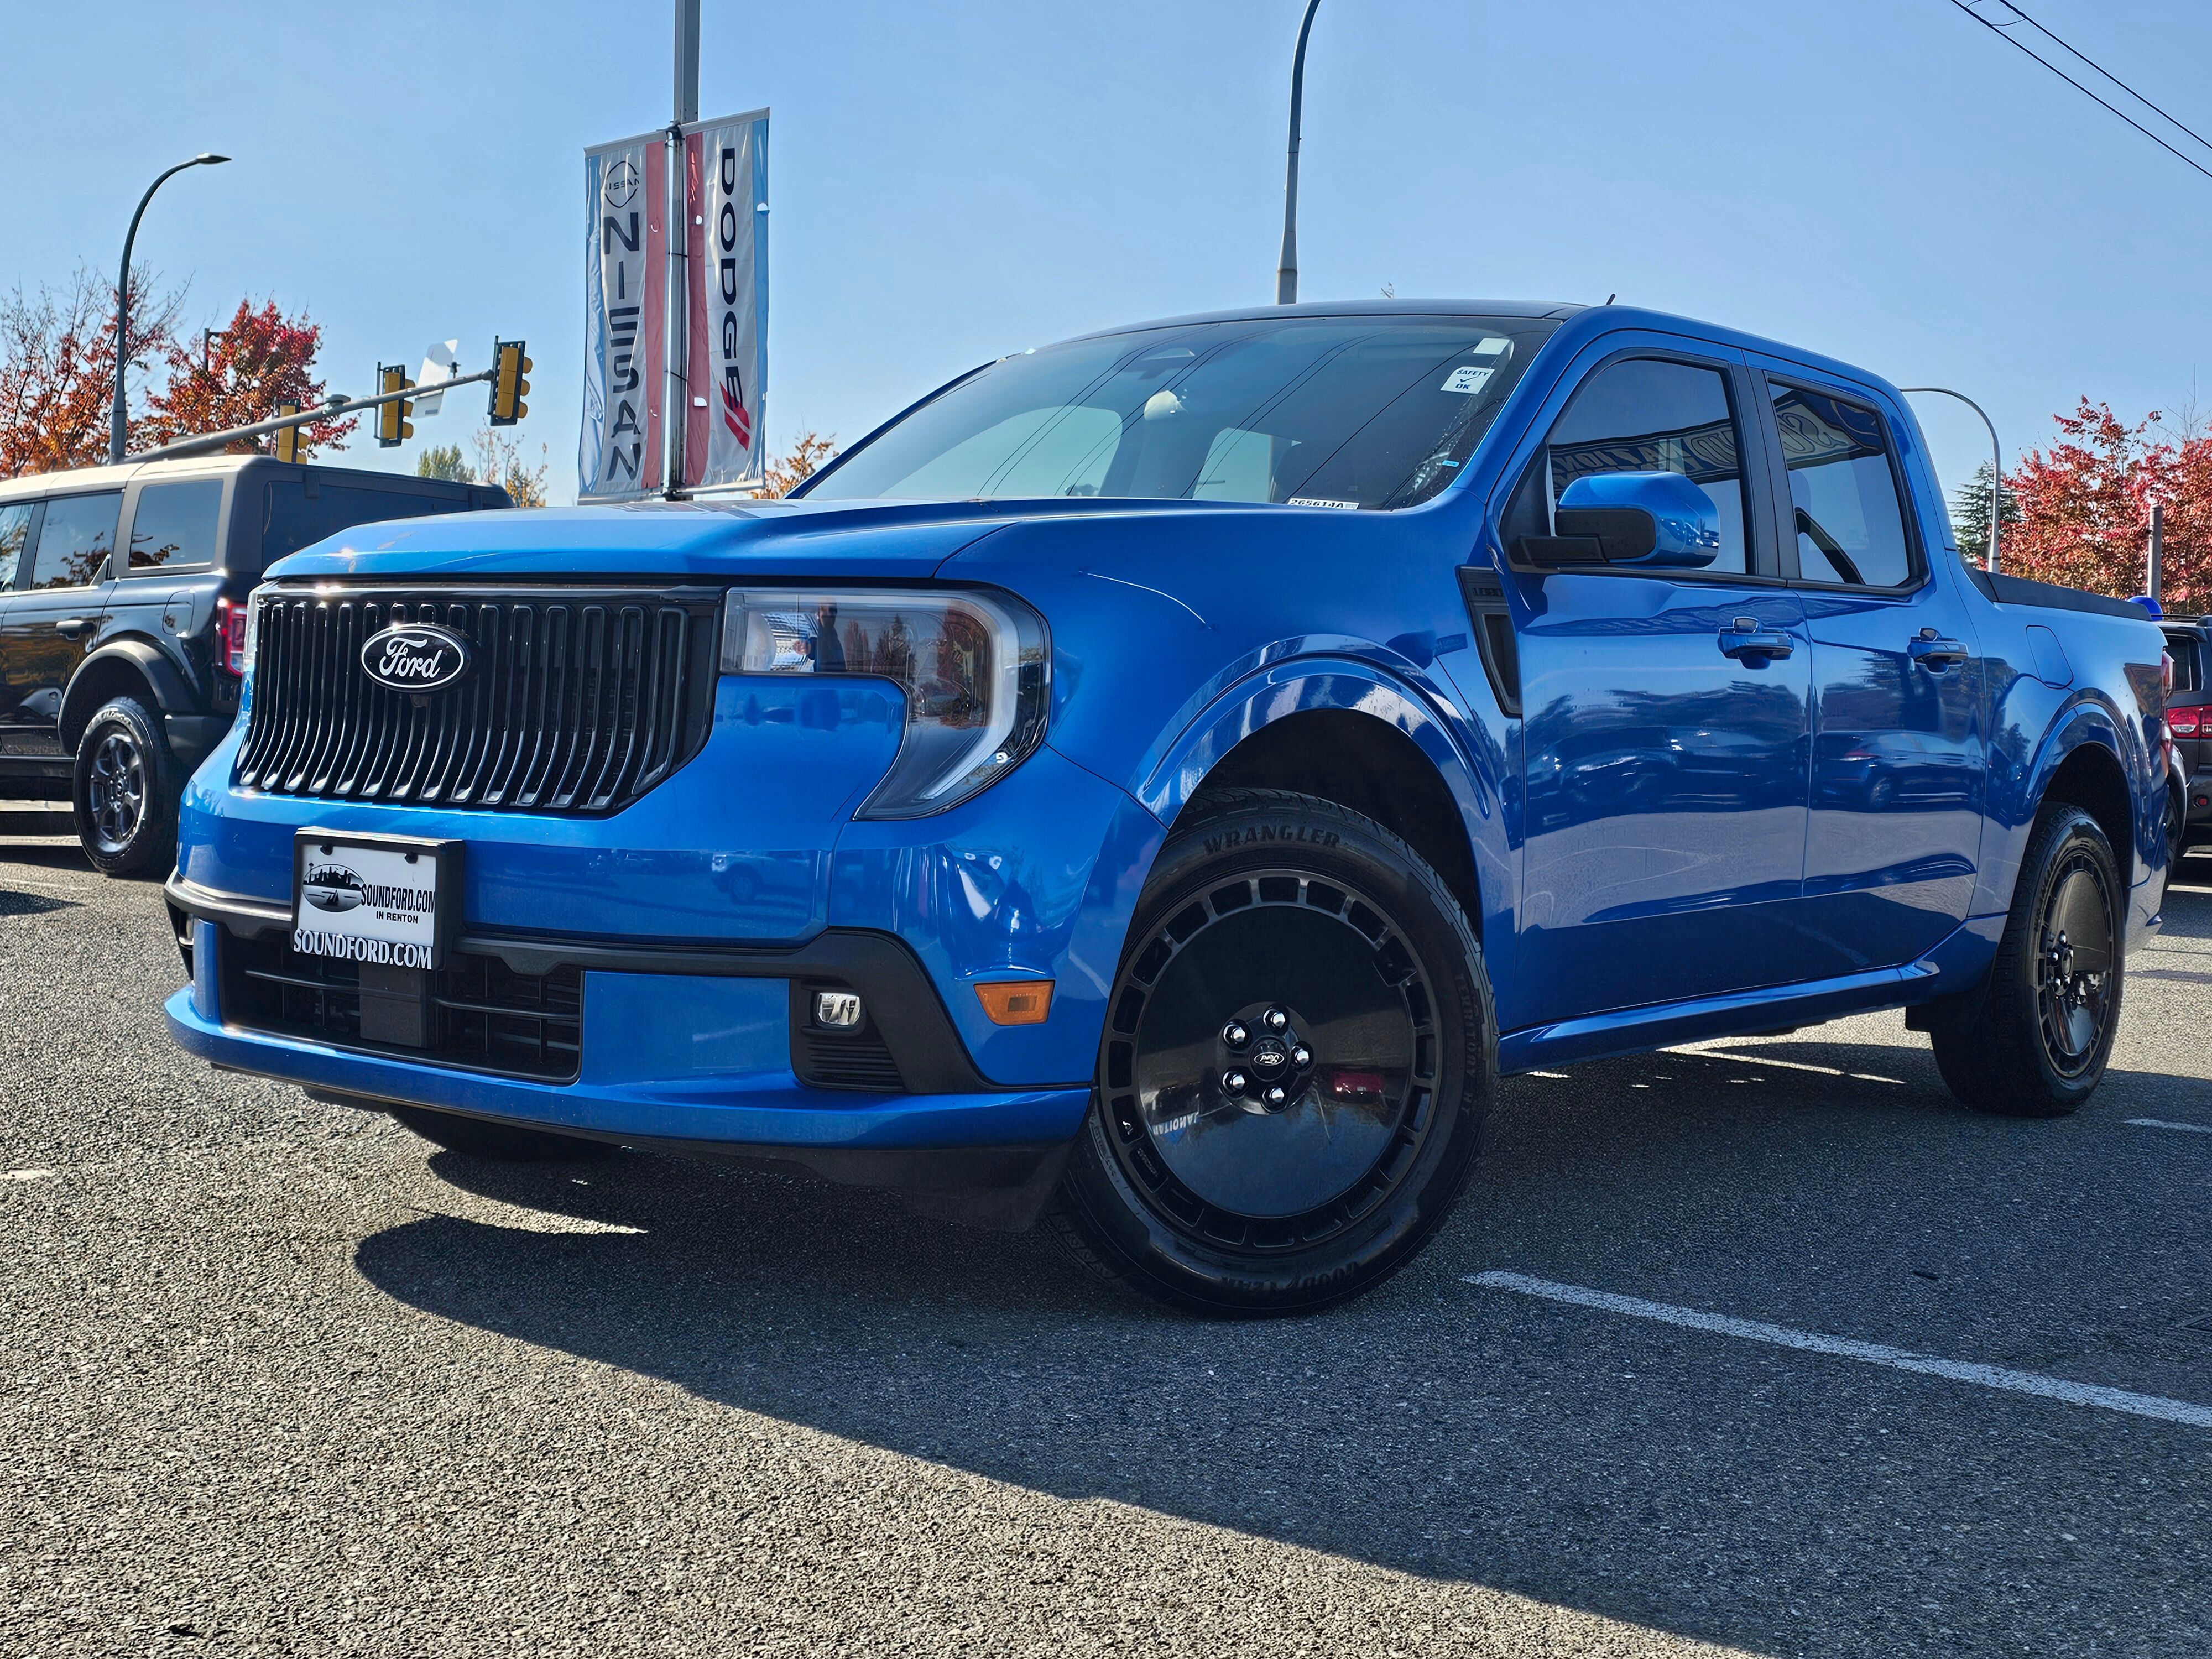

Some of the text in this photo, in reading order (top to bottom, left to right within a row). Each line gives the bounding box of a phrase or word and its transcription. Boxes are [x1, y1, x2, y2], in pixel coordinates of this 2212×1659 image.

[720, 147, 743, 410] DODGE
[603, 212, 642, 482] NISSAN
[379, 637, 442, 679] Ford
[1203, 824, 1340, 855] WRANGLER
[361, 883, 436, 914] SOUNDFORD.COM
[376, 911, 419, 924] IN RENTON
[293, 928, 432, 970] SOUNDFORD.COM
